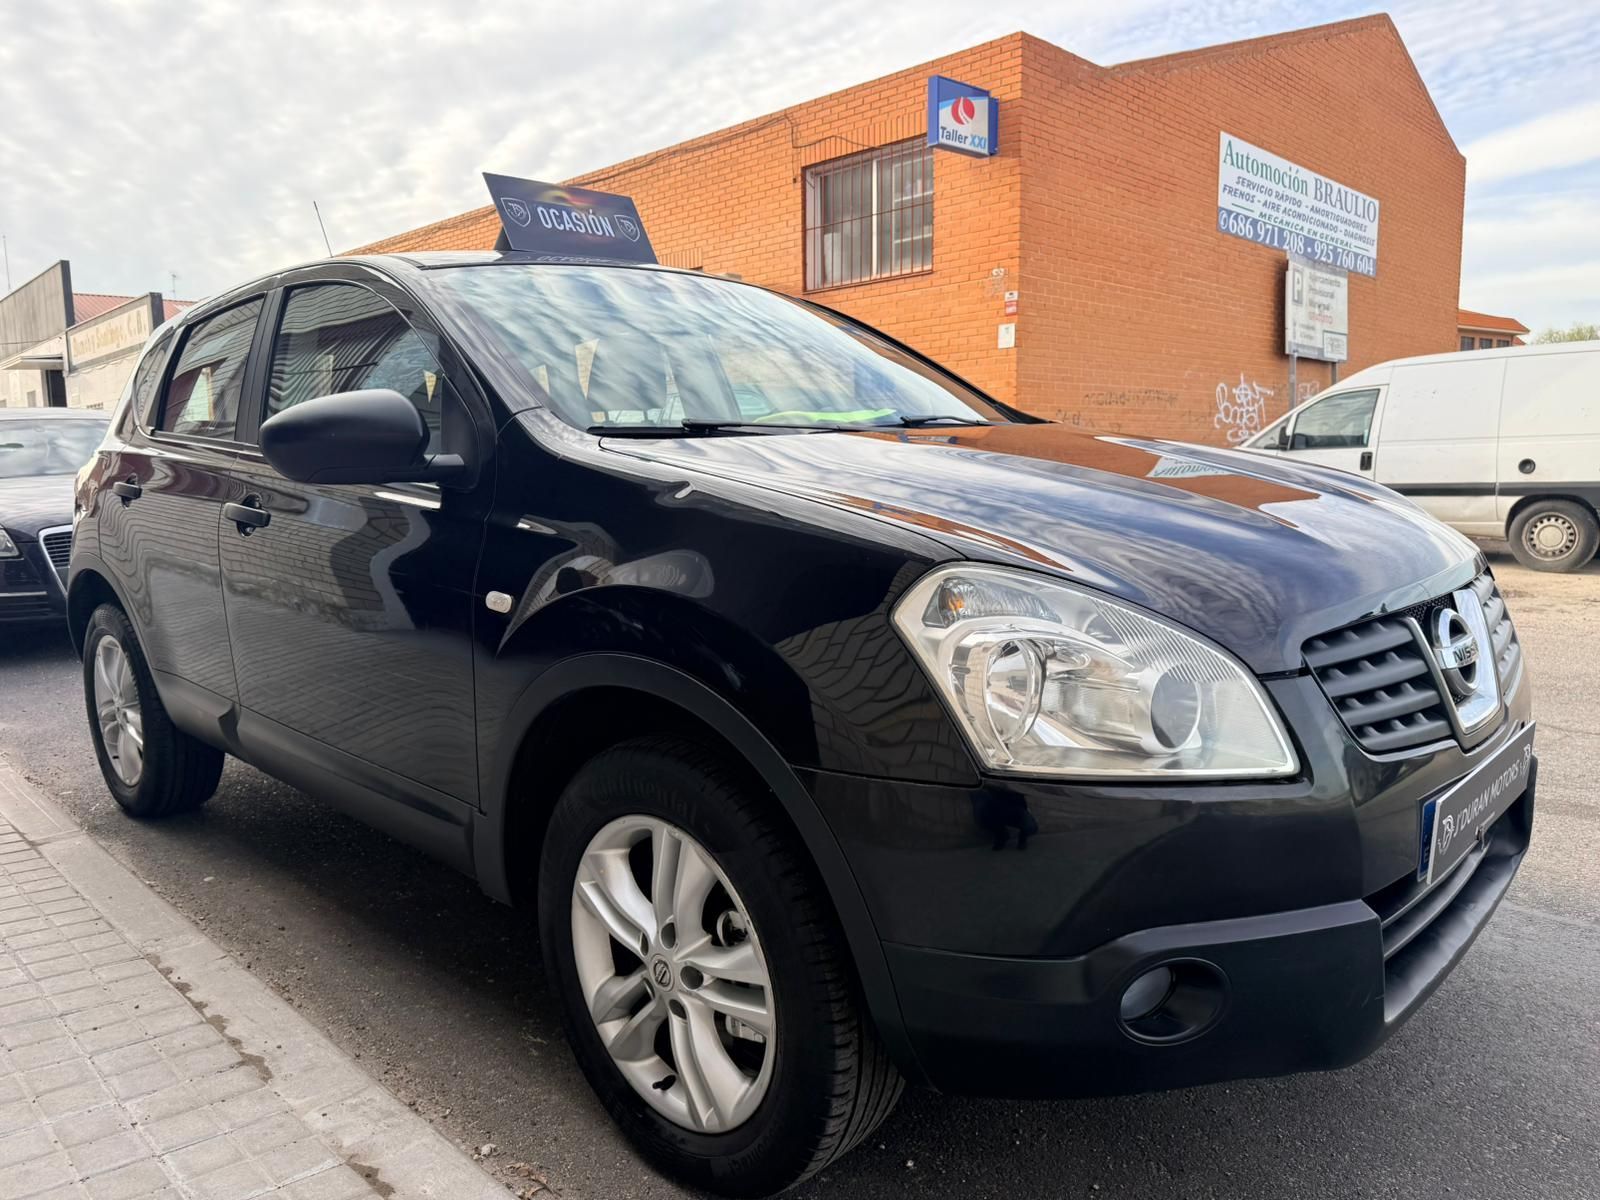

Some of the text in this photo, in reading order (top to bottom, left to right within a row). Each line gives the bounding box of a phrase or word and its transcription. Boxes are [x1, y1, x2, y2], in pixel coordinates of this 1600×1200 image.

[941, 126, 986, 149] Taller XXI
[1223, 140, 1376, 223] Automoción BRAULIO
[1236, 176, 1273, 197] SERVICIO
[1275, 188, 1302, 208] RÁPIDO
[1310, 205, 1367, 232] AMORTIGUADORES
[537, 207, 616, 238] OCASIÓN
[1223, 184, 1256, 204] FRENOS
[1263, 199, 1281, 213] AIRE
[1283, 206, 1338, 233] ACONDICIONADO
[1344, 228, 1375, 247] DIAGNOSIS
[1307, 228, 1317, 238] EN
[1319, 232, 1353, 249] GENERAL
[1229, 213, 1374, 276] 686 971 208 925 760 604
[1490, 759, 1520, 804] MOTORS
